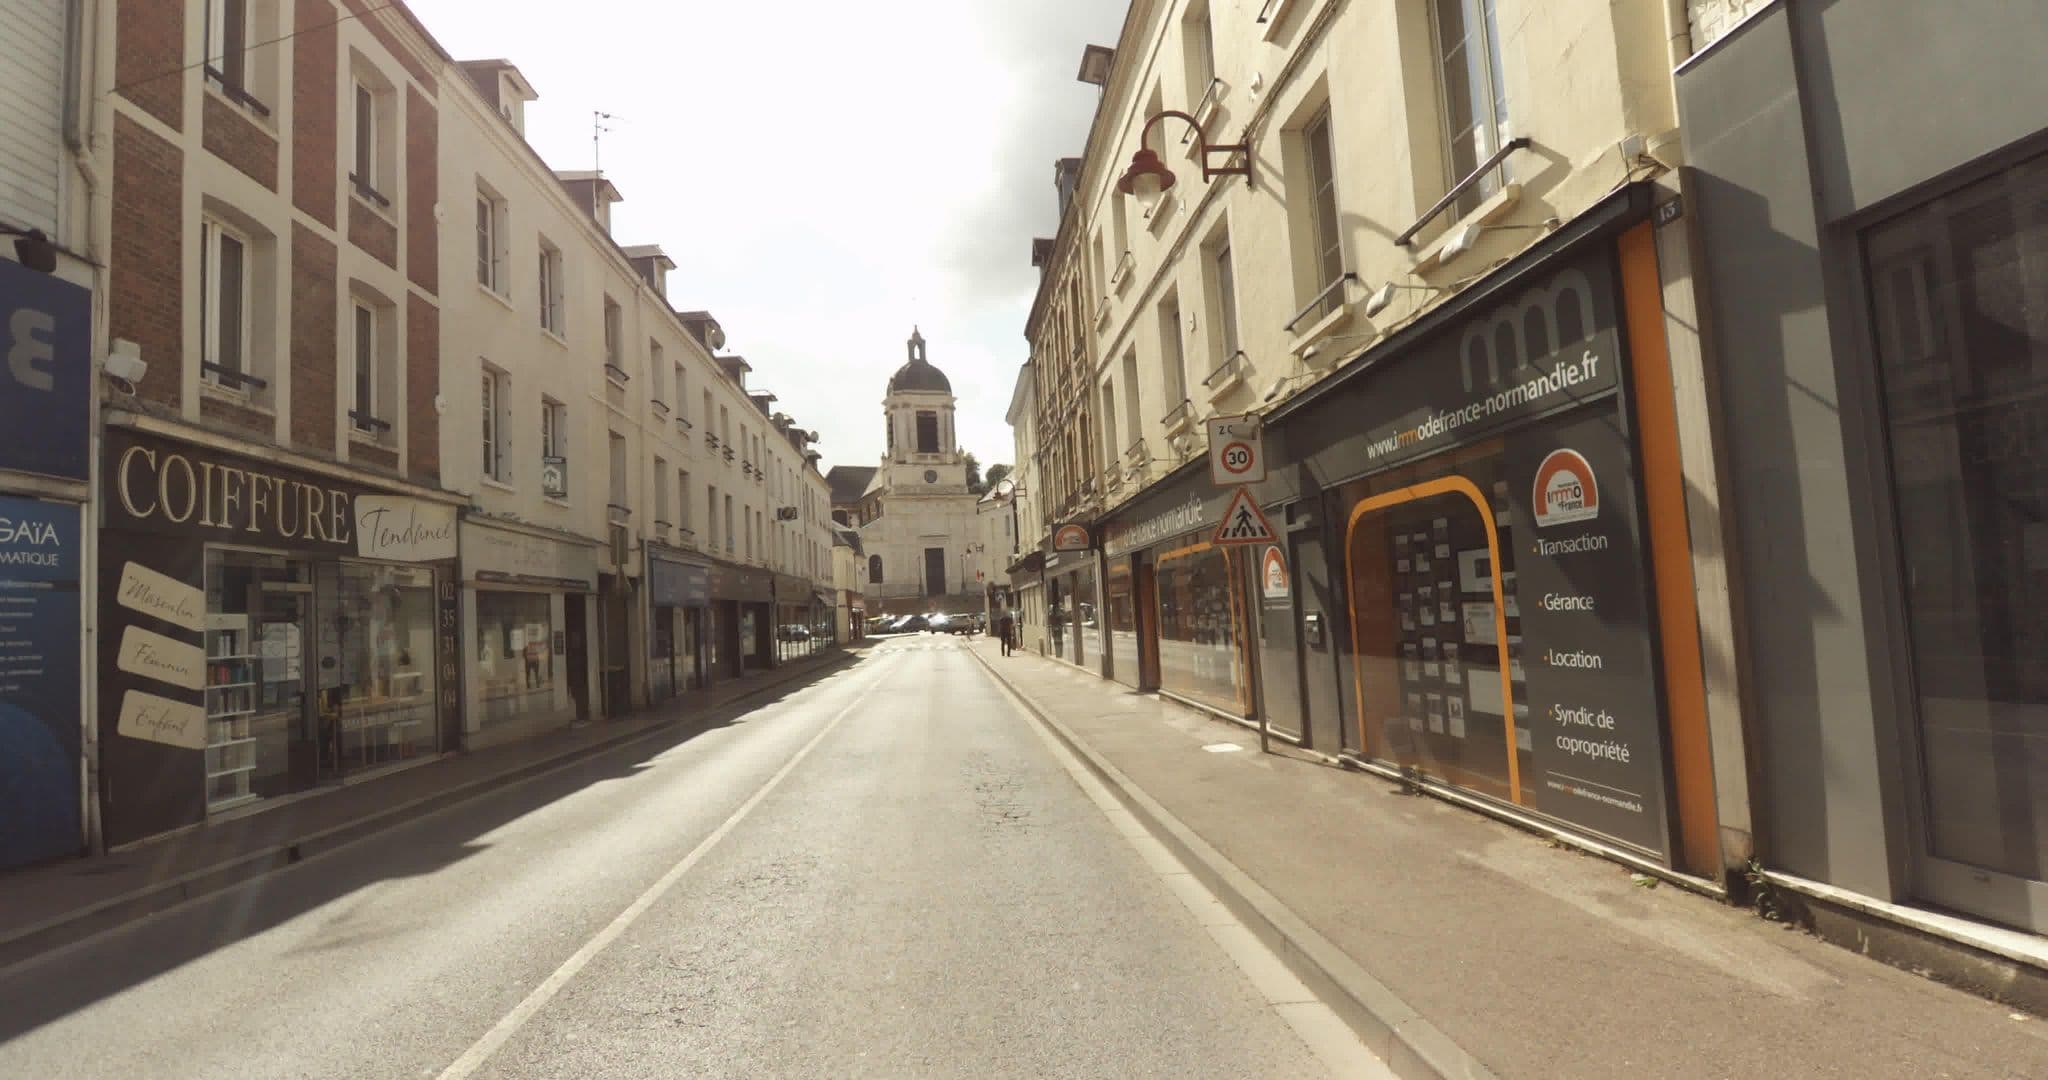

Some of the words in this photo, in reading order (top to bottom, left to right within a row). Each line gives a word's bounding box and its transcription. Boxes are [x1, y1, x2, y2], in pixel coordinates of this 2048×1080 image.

[1367, 350, 1599, 460] www.immodefrance-normandie.fr
[1228, 450, 1248, 465] 30
[117, 444, 350, 544] COIFFURE
[360, 503, 450, 552] Tendance
[1537, 532, 1608, 556] Transaction
[1544, 592, 1594, 612] Gérance
[1549, 648, 1602, 669] Location
[1555, 703, 1595, 726] Syndic
[1597, 709, 1615, 730] de
[1556, 734, 1630, 763] copropriété
